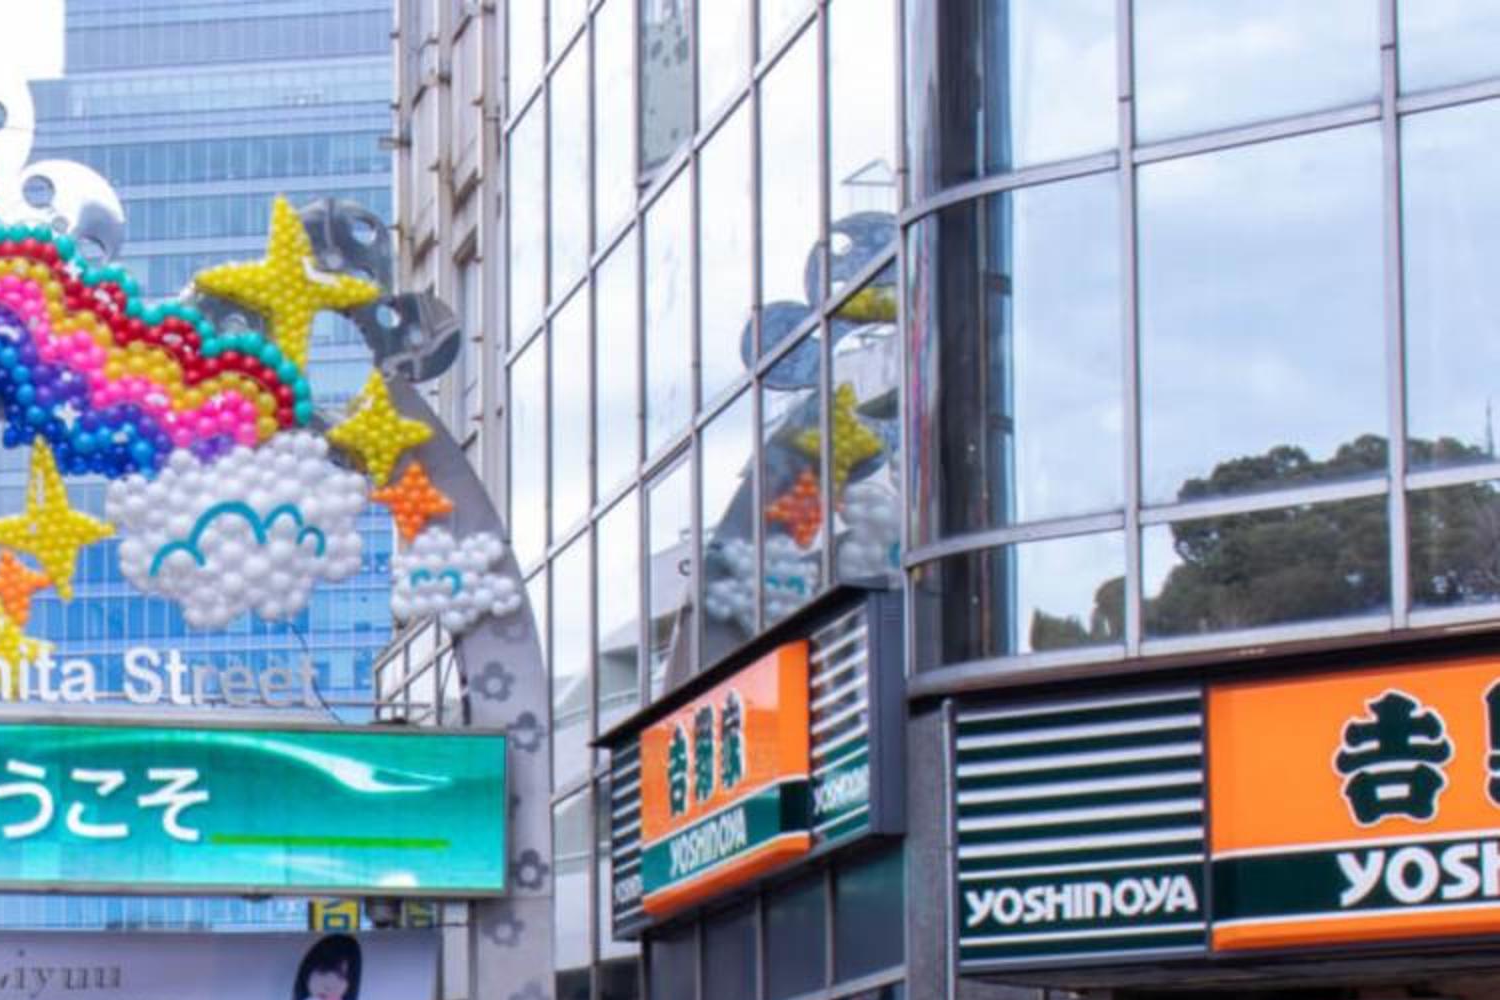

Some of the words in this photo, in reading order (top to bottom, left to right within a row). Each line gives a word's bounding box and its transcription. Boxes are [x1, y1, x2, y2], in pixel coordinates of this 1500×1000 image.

[123, 646, 317, 707] Street
[1332, 676, 1500, 828] 吉
[965, 874, 1199, 928] YOSHINOYA
